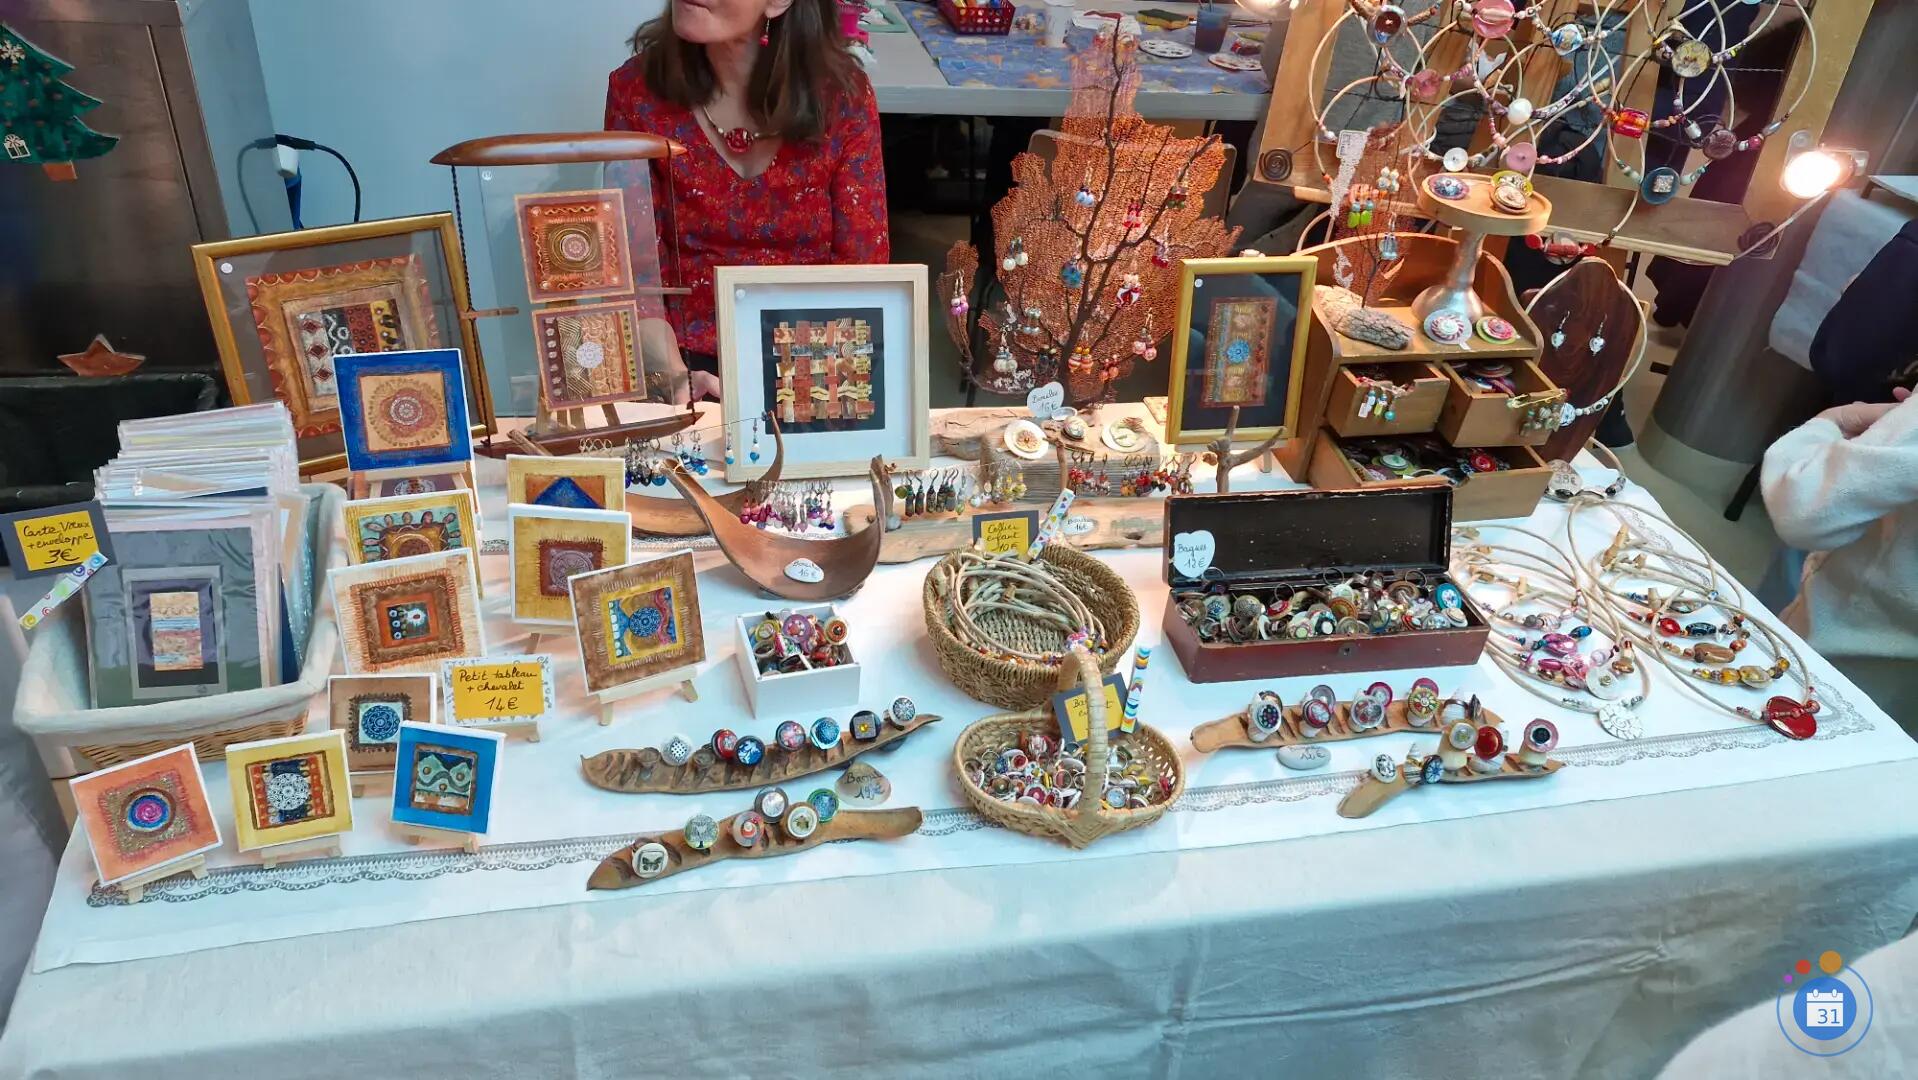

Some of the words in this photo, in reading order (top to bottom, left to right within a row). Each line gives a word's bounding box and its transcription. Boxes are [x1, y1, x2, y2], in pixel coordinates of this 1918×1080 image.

[23, 525, 57, 537] Carte
[986, 531, 1020, 552] enfant
[44, 548, 81, 564] 3€
[459, 669, 489, 683] Petit
[491, 666, 538, 679] tableau
[466, 685, 475, 694] +
[476, 680, 525, 692] chevalet
